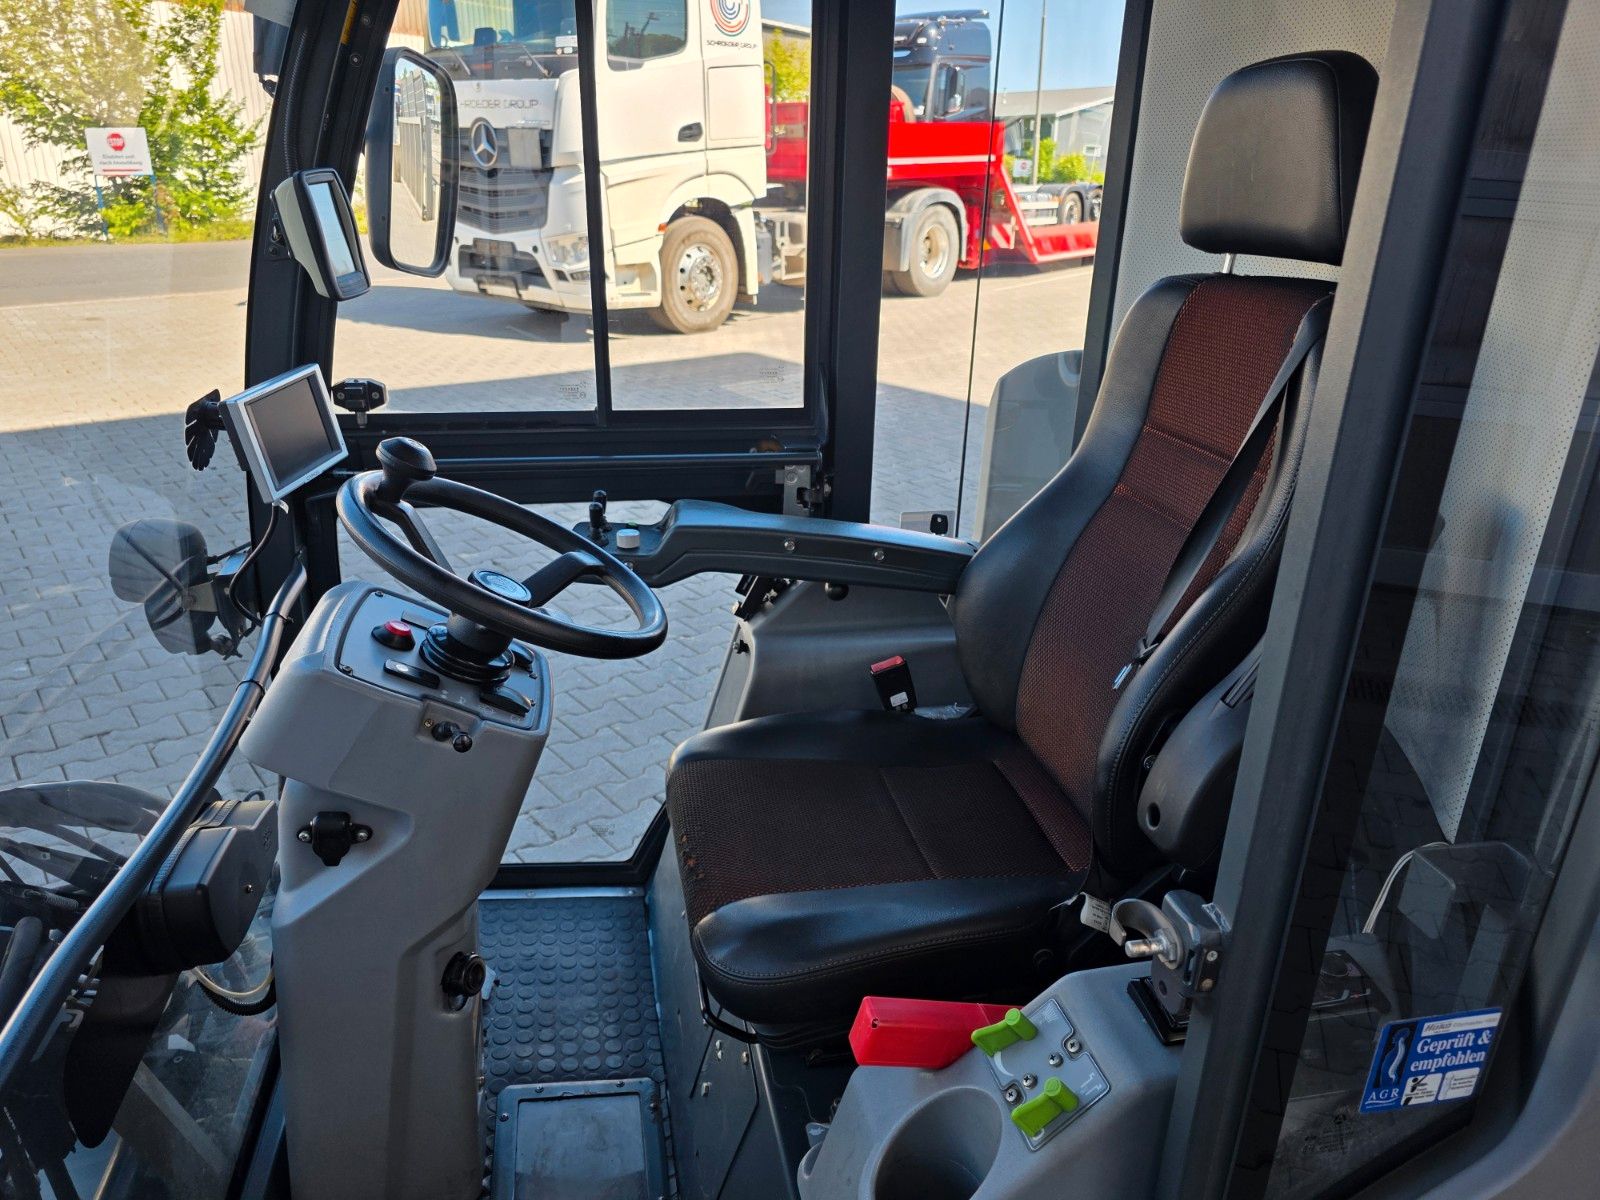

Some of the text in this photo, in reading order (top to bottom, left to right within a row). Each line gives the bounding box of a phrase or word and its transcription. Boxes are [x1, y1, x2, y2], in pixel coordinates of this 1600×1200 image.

[1416, 1029, 1492, 1054] Geprüft &
[1410, 1050, 1486, 1072] empfohlen
